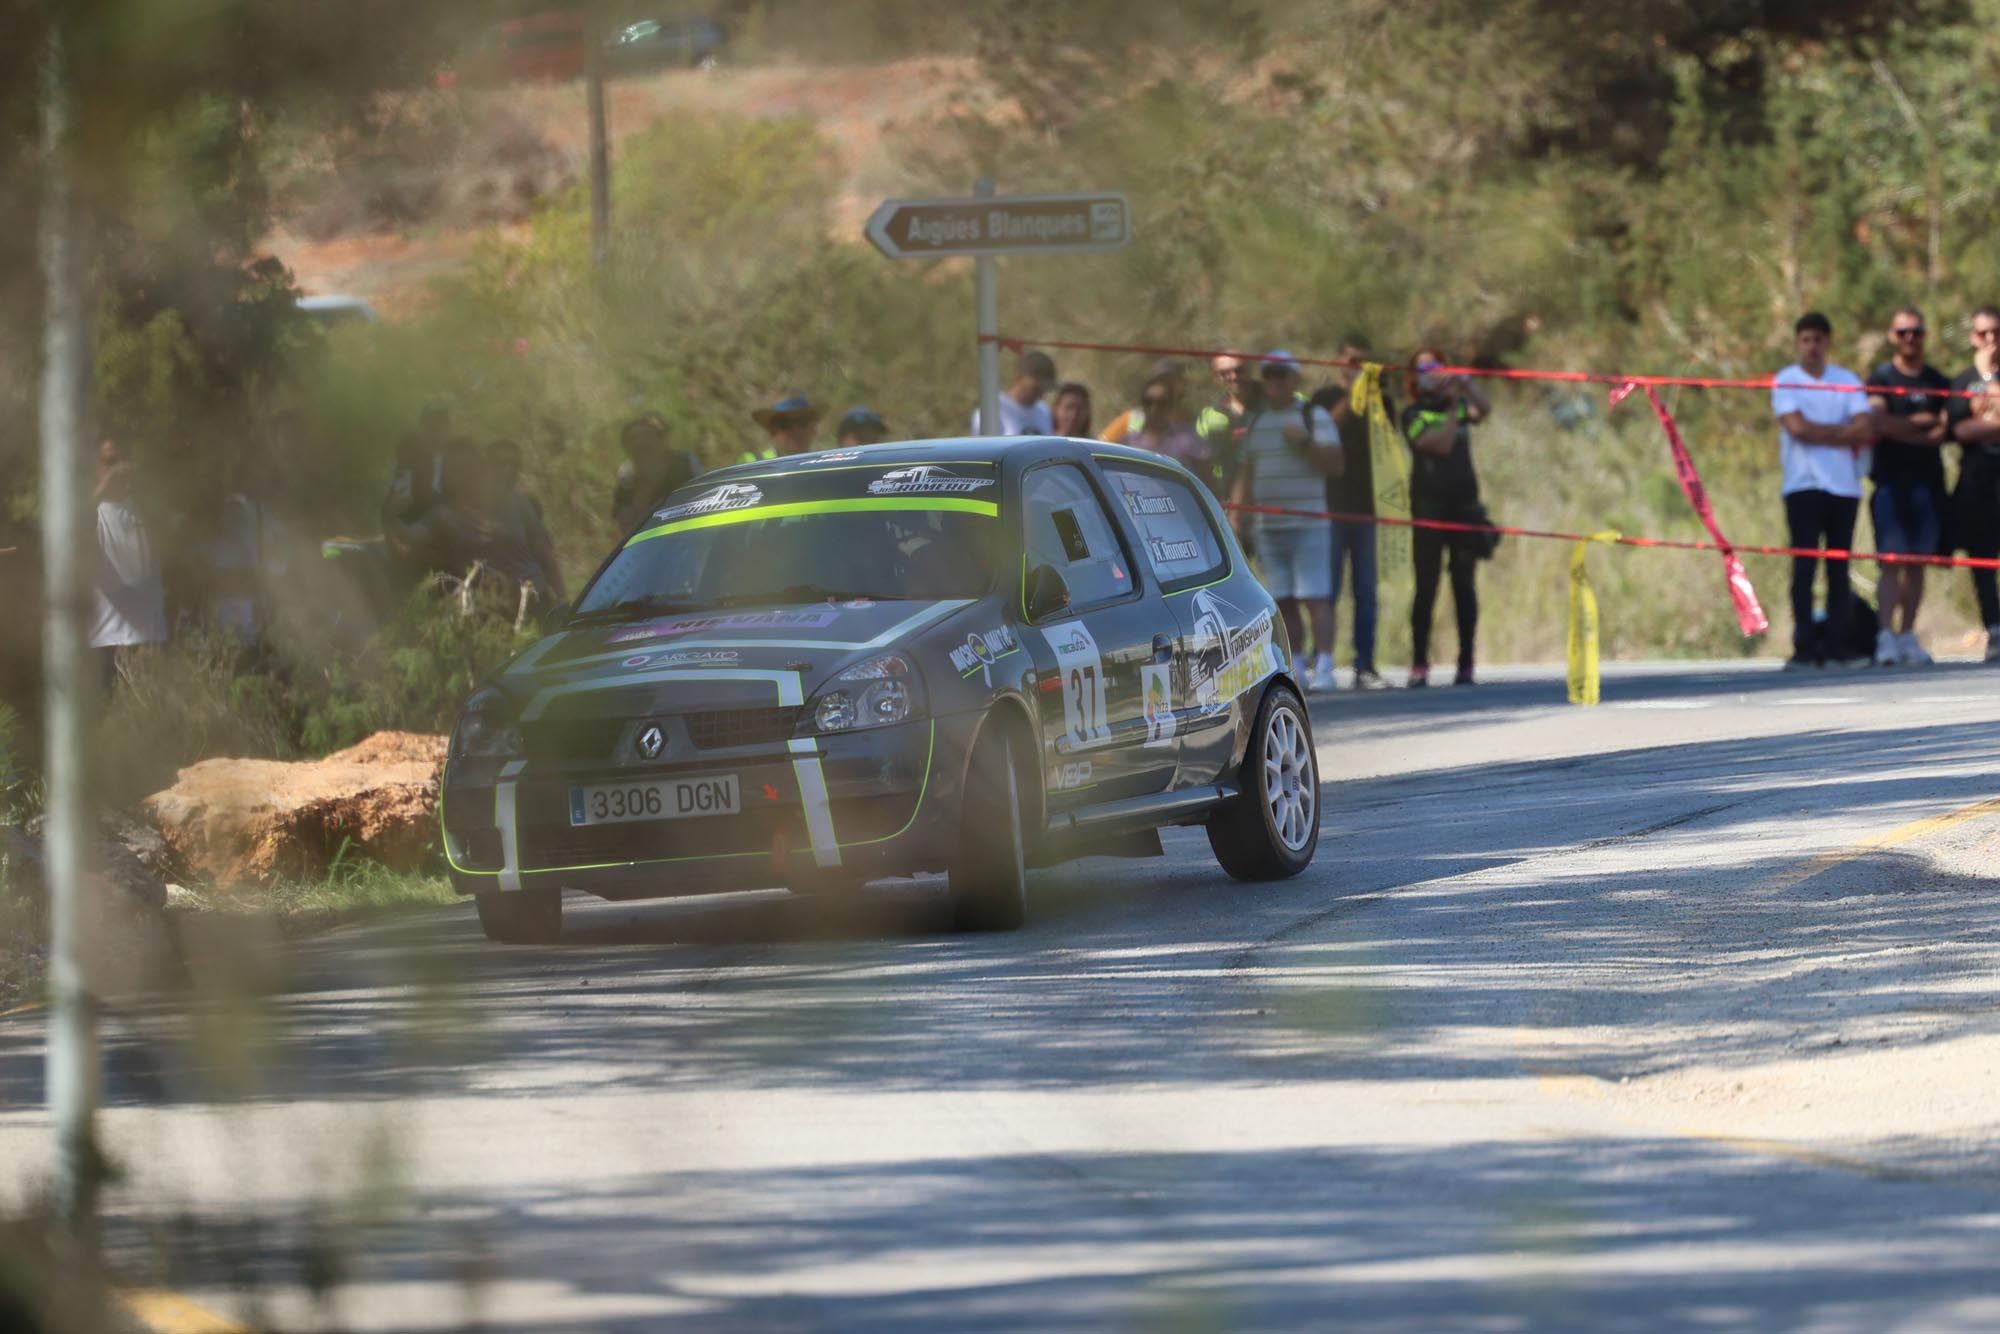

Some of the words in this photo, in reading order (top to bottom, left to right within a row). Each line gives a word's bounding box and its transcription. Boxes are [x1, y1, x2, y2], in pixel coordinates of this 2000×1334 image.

[906, 214, 979, 245] Aigües
[987, 210, 1086, 242] Blanques
[1230, 615, 1270, 658] TRANSPORTES
[1071, 665, 1098, 743] 37
[592, 786, 662, 819] 3306
[676, 780, 732, 813] DGN
